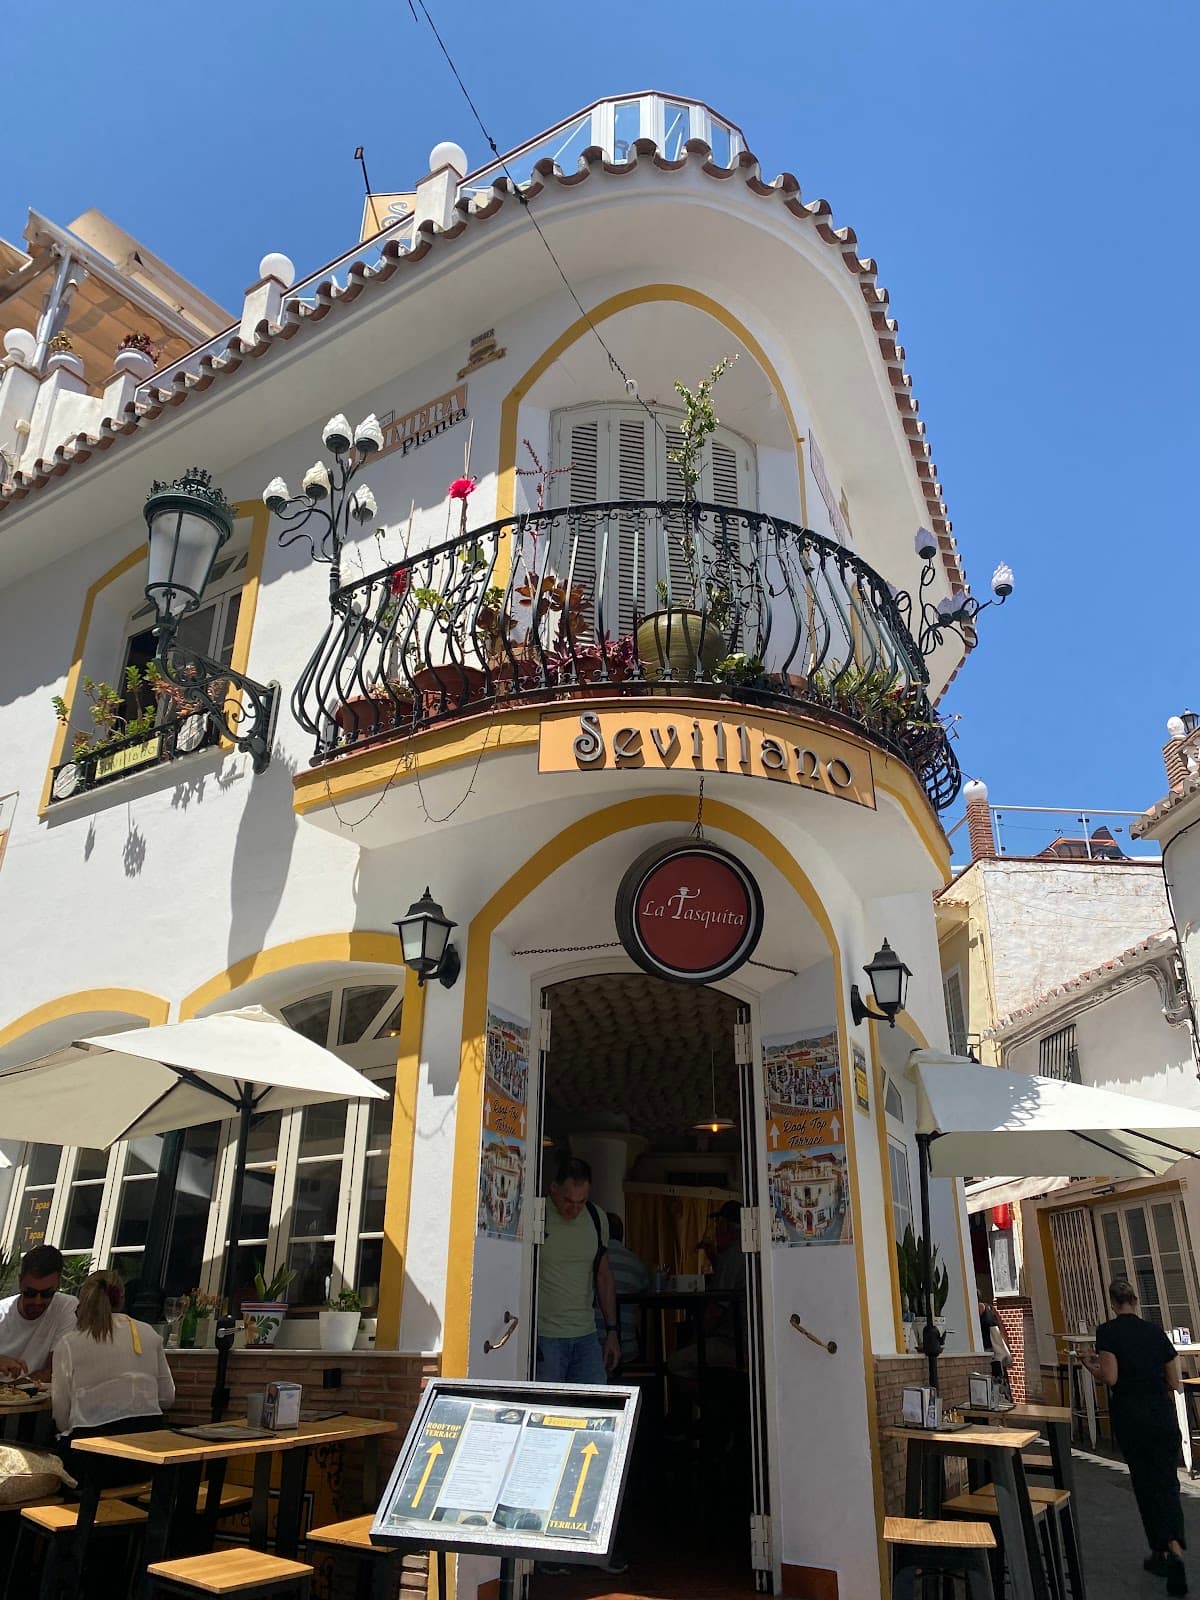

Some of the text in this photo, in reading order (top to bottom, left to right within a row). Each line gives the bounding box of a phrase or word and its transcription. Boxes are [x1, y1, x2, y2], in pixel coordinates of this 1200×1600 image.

[402, 407, 467, 457] Planta
[573, 711, 852, 788] Sevillano
[641, 888, 744, 928] La Tasquita
[810, 1116, 827, 1134] Top
[425, 1429, 460, 1439] TERRACE
[426, 1422, 462, 1432] ROOFTOP
[549, 1520, 588, 1531] TERRAZA
